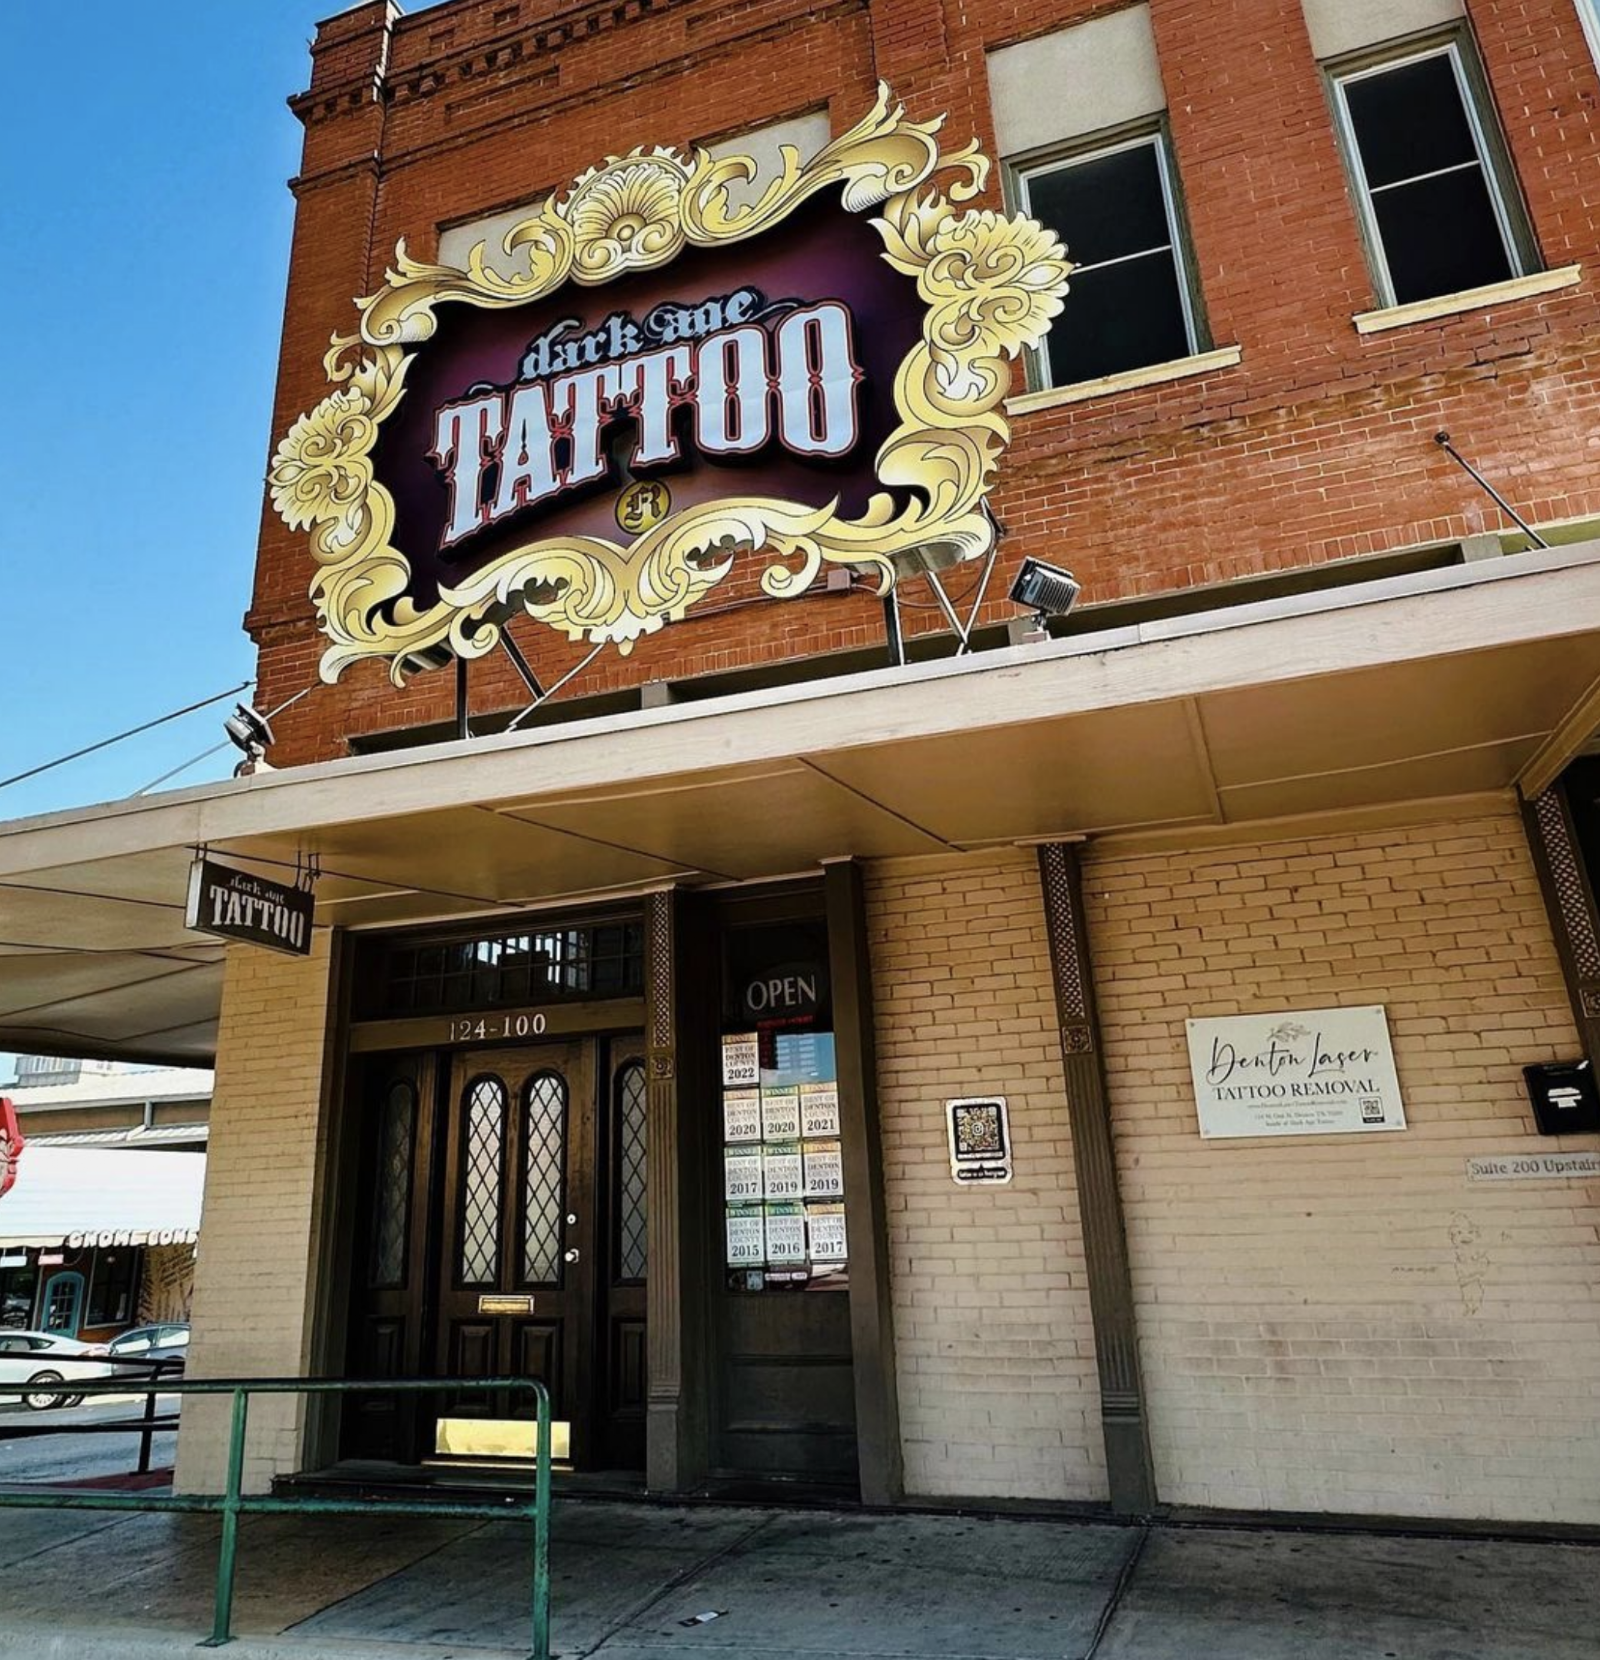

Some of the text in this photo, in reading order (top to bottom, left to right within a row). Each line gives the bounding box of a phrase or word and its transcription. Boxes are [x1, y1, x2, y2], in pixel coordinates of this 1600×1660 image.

[520, 315, 643, 381] dark
[430, 301, 865, 550] TATTOO
[209, 884, 305, 948] TATTOO
[746, 974, 816, 1010] OPEN
[450, 1013, 546, 1041] 124-100
[725, 1053, 756, 1061] DENTON
[1206, 1032, 1378, 1086] Denton Laser
[728, 1067, 755, 1080] 2022
[1214, 1079, 1380, 1101] TATTOO REMOVAL
[729, 1123, 757, 1136] 2020
[767, 1121, 796, 1134] 2020
[807, 1118, 836, 1132] 2021
[1471, 1162, 1508, 1175] Suite
[1512, 1160, 1540, 1173] 200
[730, 1182, 758, 1195] 2017
[770, 1181, 798, 1193] 2019
[809, 1178, 839, 1191] 2019
[731, 1245, 760, 1257] 2015
[771, 1242, 800, 1255] 2016
[814, 1240, 843, 1254] 2017
